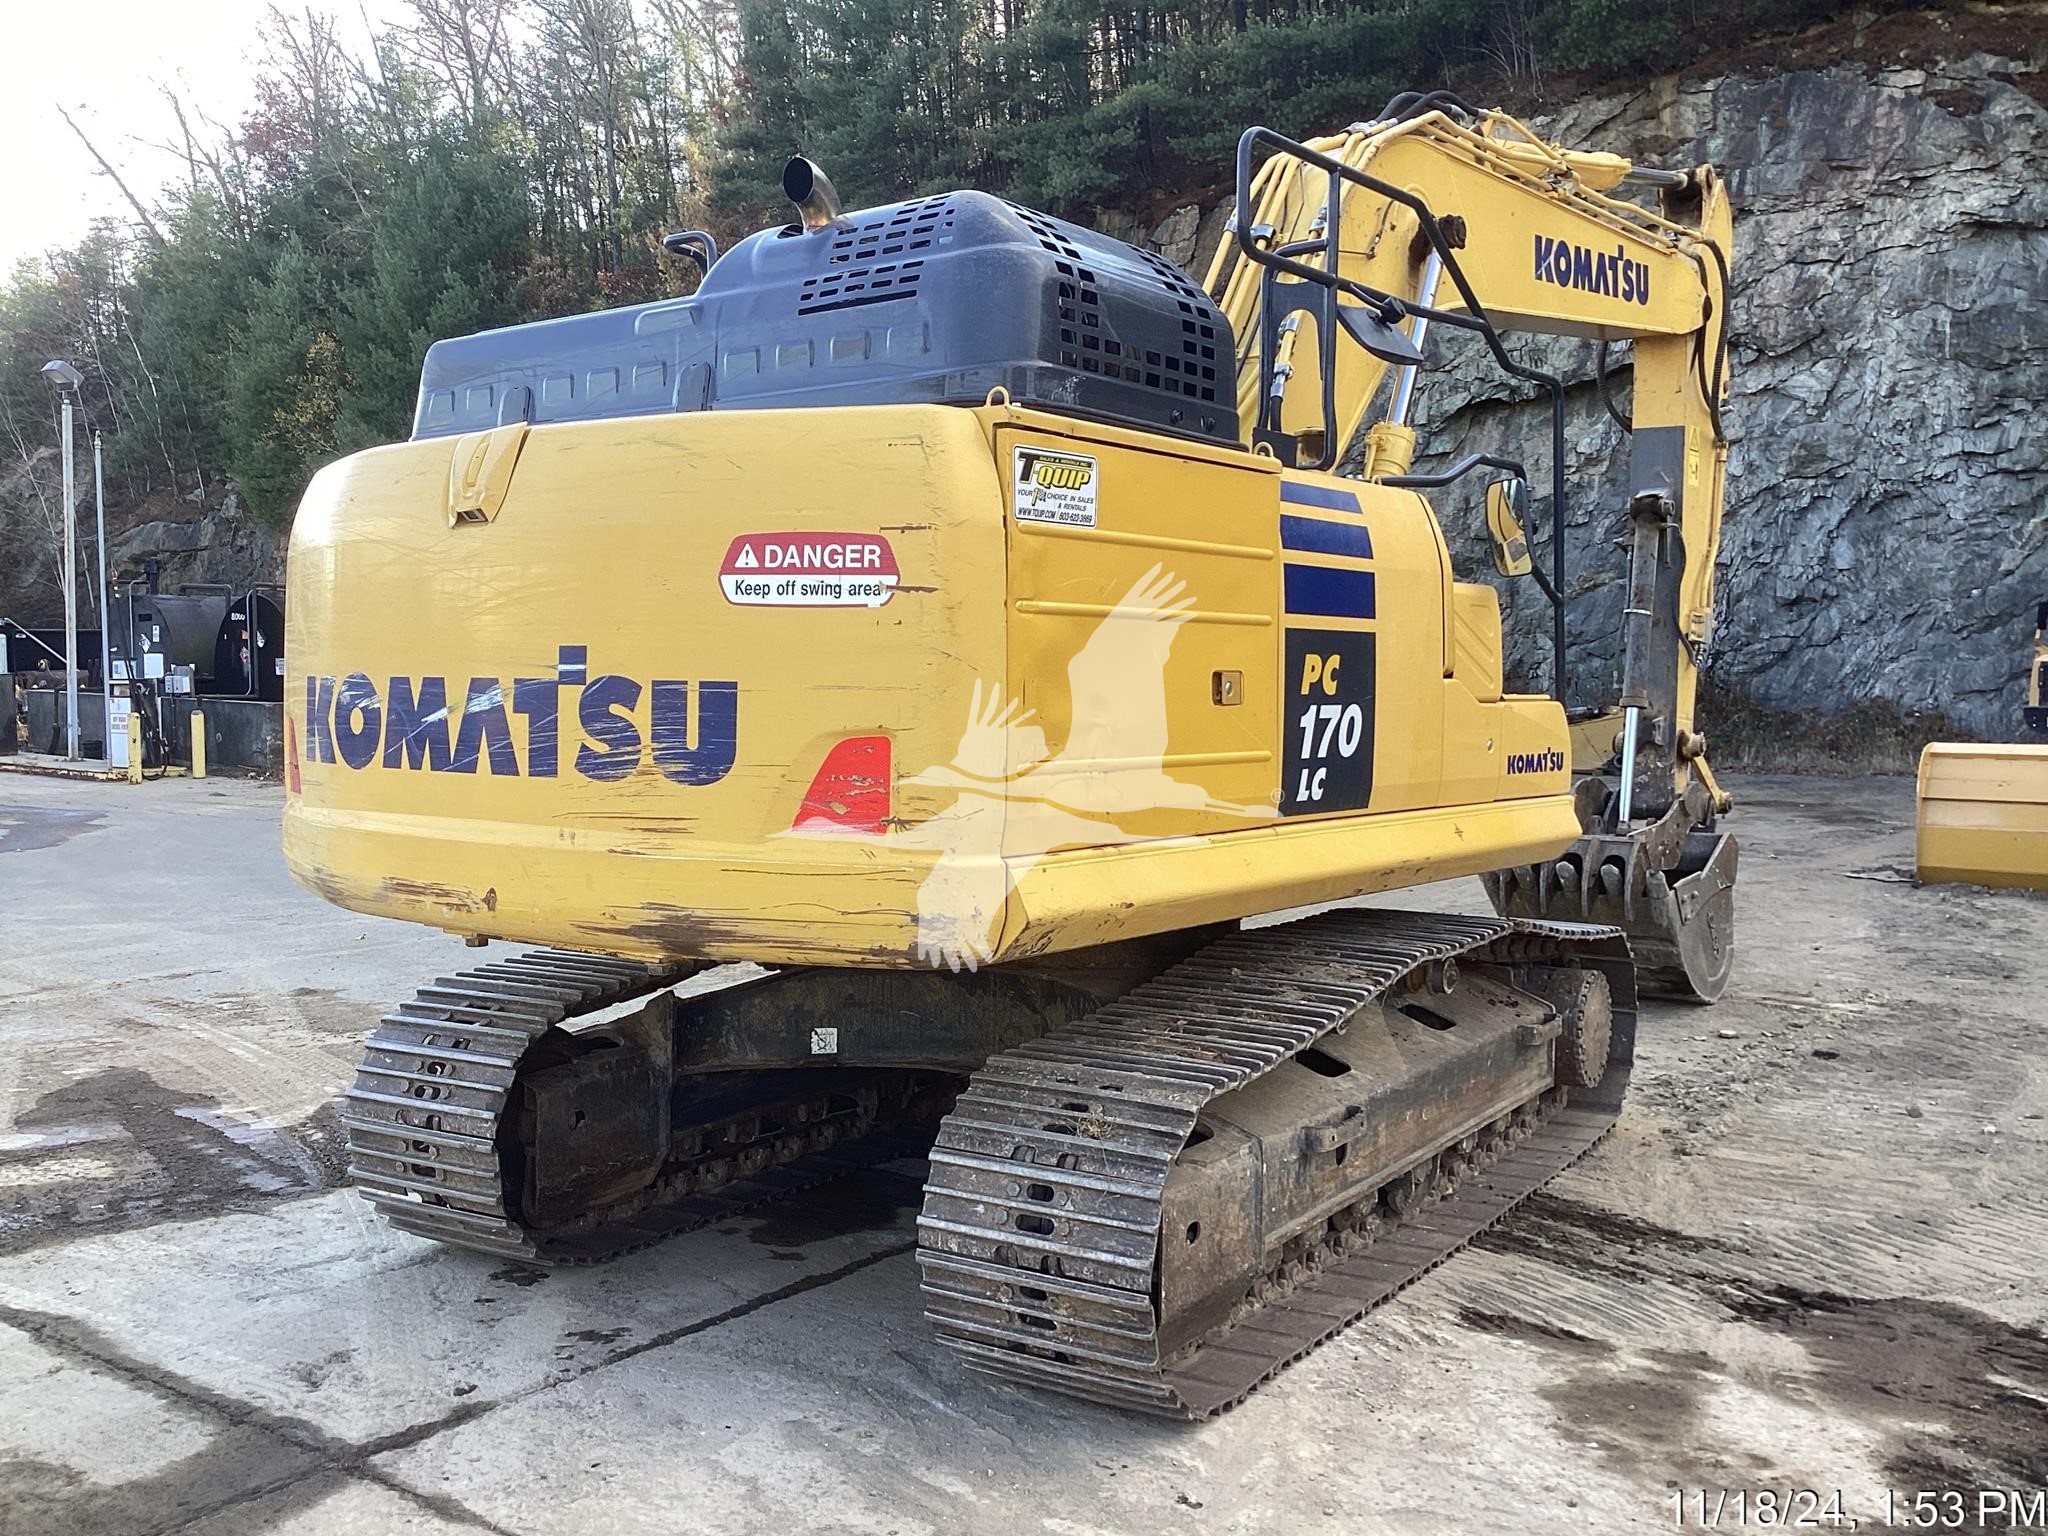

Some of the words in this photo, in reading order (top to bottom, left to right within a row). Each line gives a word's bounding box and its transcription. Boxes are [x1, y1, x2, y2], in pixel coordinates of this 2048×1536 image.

[1534, 234, 1649, 306] KOMATSU
[1017, 488, 1033, 497] YOUR
[1046, 492, 1069, 501] CHOICE
[1077, 496, 1094, 505] SALES
[1063, 503, 1087, 512] RENTALS
[764, 544, 881, 568] DANGER
[735, 579, 770, 598] Keep
[776, 579, 795, 596] off
[801, 579, 842, 599] swing
[848, 583, 881, 596] area
[1300, 653, 1340, 696] PC
[305, 645, 739, 787] KOMATSU
[1299, 703, 1363, 760] 170
[1506, 747, 1564, 775] KOMATSU
[1295, 767, 1326, 802] LC
